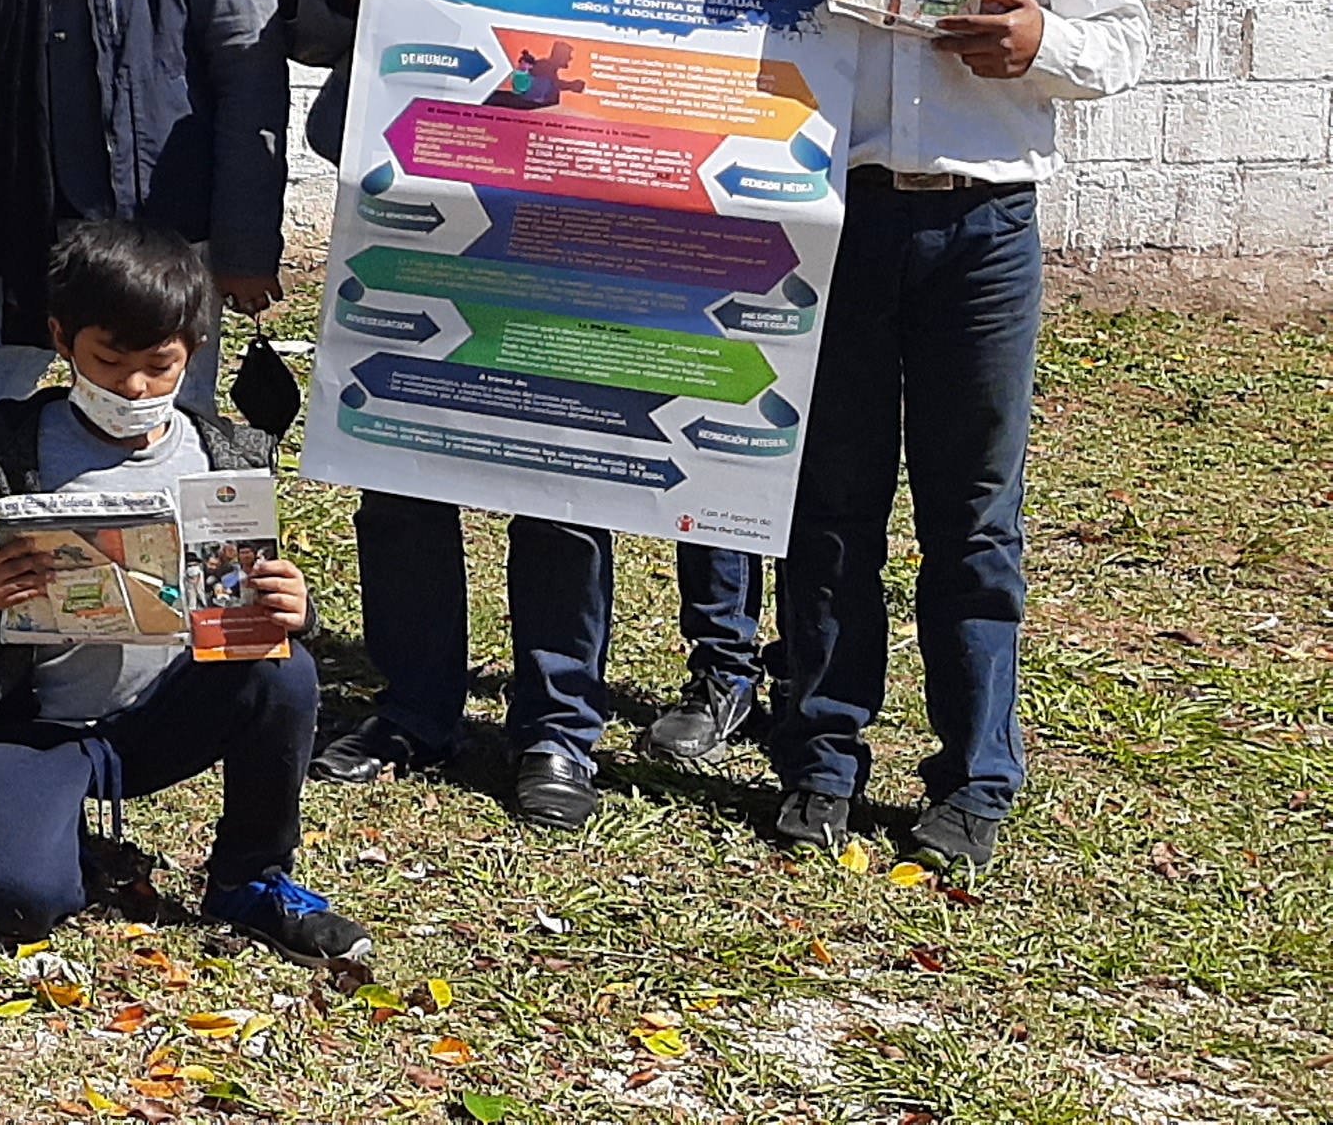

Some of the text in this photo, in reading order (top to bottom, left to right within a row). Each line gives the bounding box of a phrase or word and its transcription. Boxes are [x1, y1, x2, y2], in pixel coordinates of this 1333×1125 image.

[684, 3, 704, 14] DE
[612, 6, 622, 16] Y
[622, 7, 719, 26] ADOLESCENTES
[399, 51, 461, 69] DENUNCIA
[700, 508, 719, 517] Con
